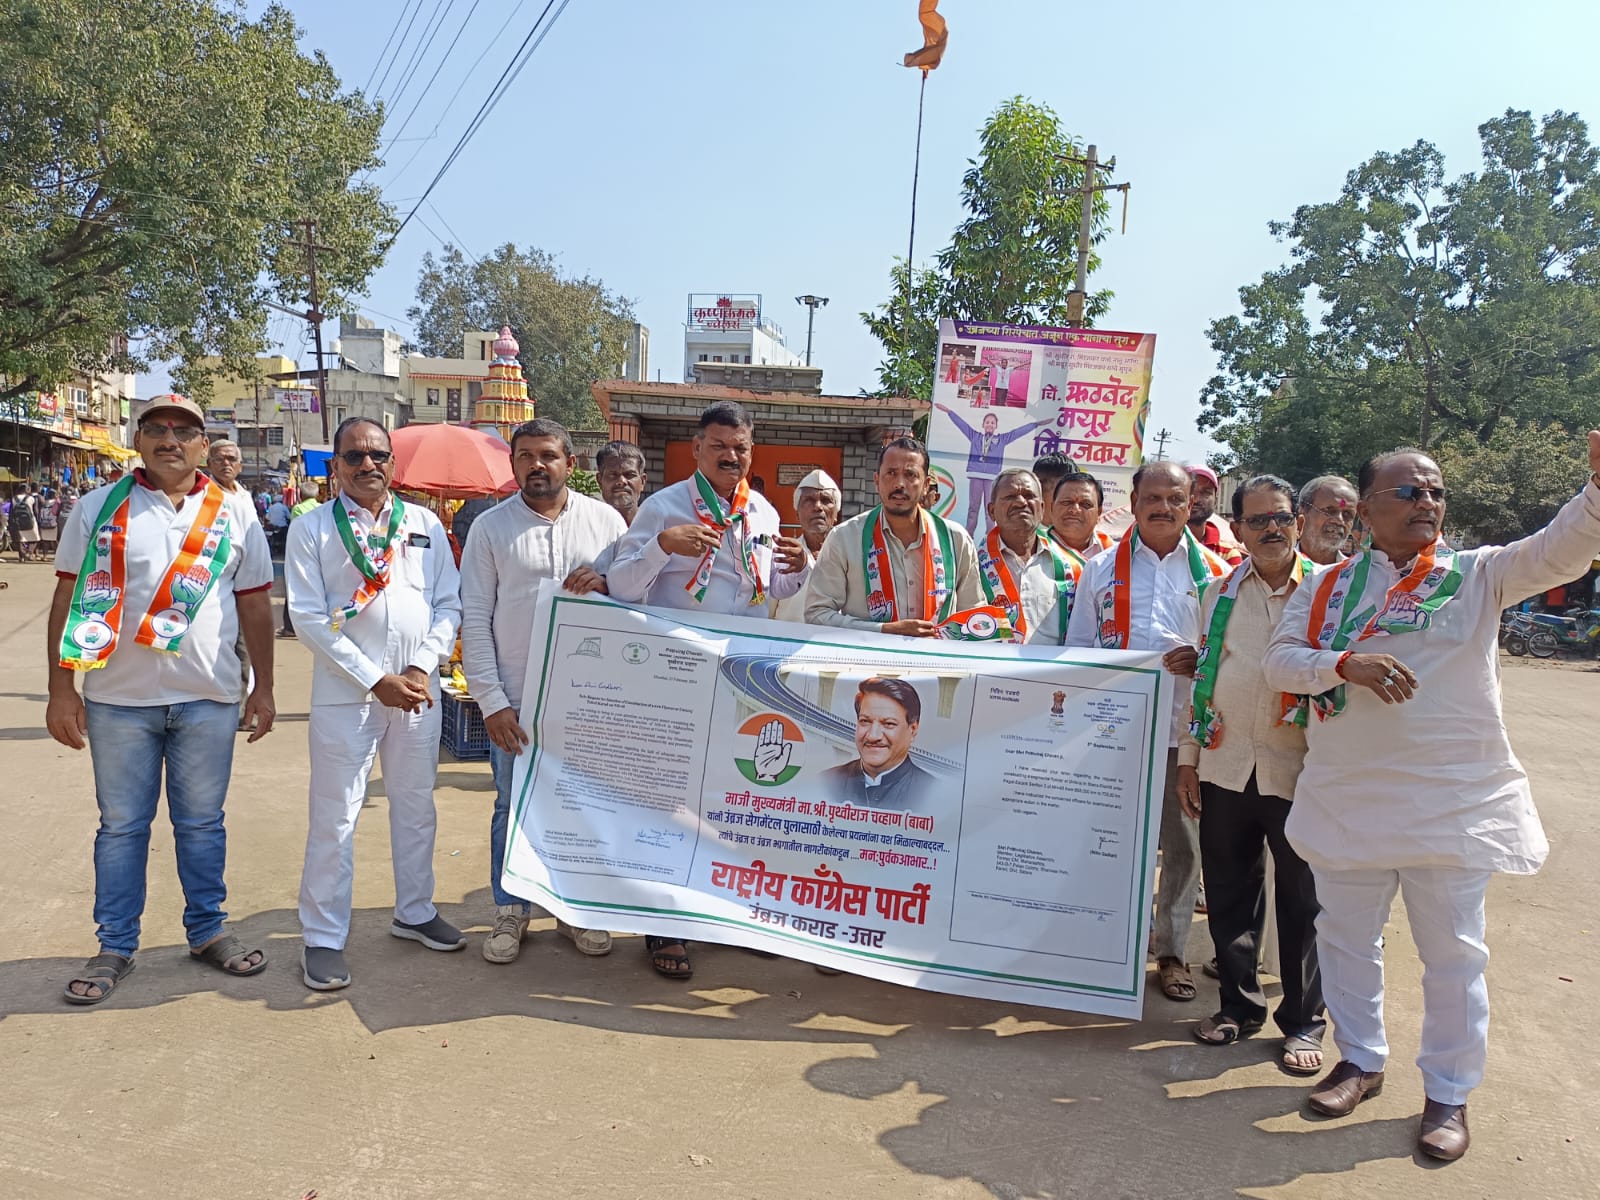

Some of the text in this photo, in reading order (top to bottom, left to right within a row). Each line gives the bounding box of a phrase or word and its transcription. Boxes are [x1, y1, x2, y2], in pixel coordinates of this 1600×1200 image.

[1056, 407, 1116, 438] मयूर
[707, 810, 723, 823] यांनी
[724, 809, 744, 825] उंब्रज
[745, 812, 782, 831] सेगमेंटल
[784, 820, 821, 836] पुलासाठी
[822, 825, 848, 839] केलेल्या
[849, 830, 879, 843] प्रयत्नांना
[880, 834, 893, 845] यश
[725, 790, 750, 807] माजी
[752, 796, 796, 813] मुख्यमंत्री
[871, 810, 903, 827] चव्हाण
[904, 812, 934, 834] (बाबा)
[718, 830, 733, 842] त्यांचे
[734, 832, 749, 844] उंब्रज
[750, 836, 756, 845] व
[757, 835, 773, 847] उंब्रज
[773, 839, 802, 852] भागातील
[804, 843, 849, 860] नागरीकांकडून
[711, 859, 788, 901] राष्ट्रीय
[790, 863, 871, 916] काँग्रेस
[874, 882, 932, 925] पार्टी
[748, 902, 788, 927] उंब्रज
[791, 914, 839, 939] कराड
